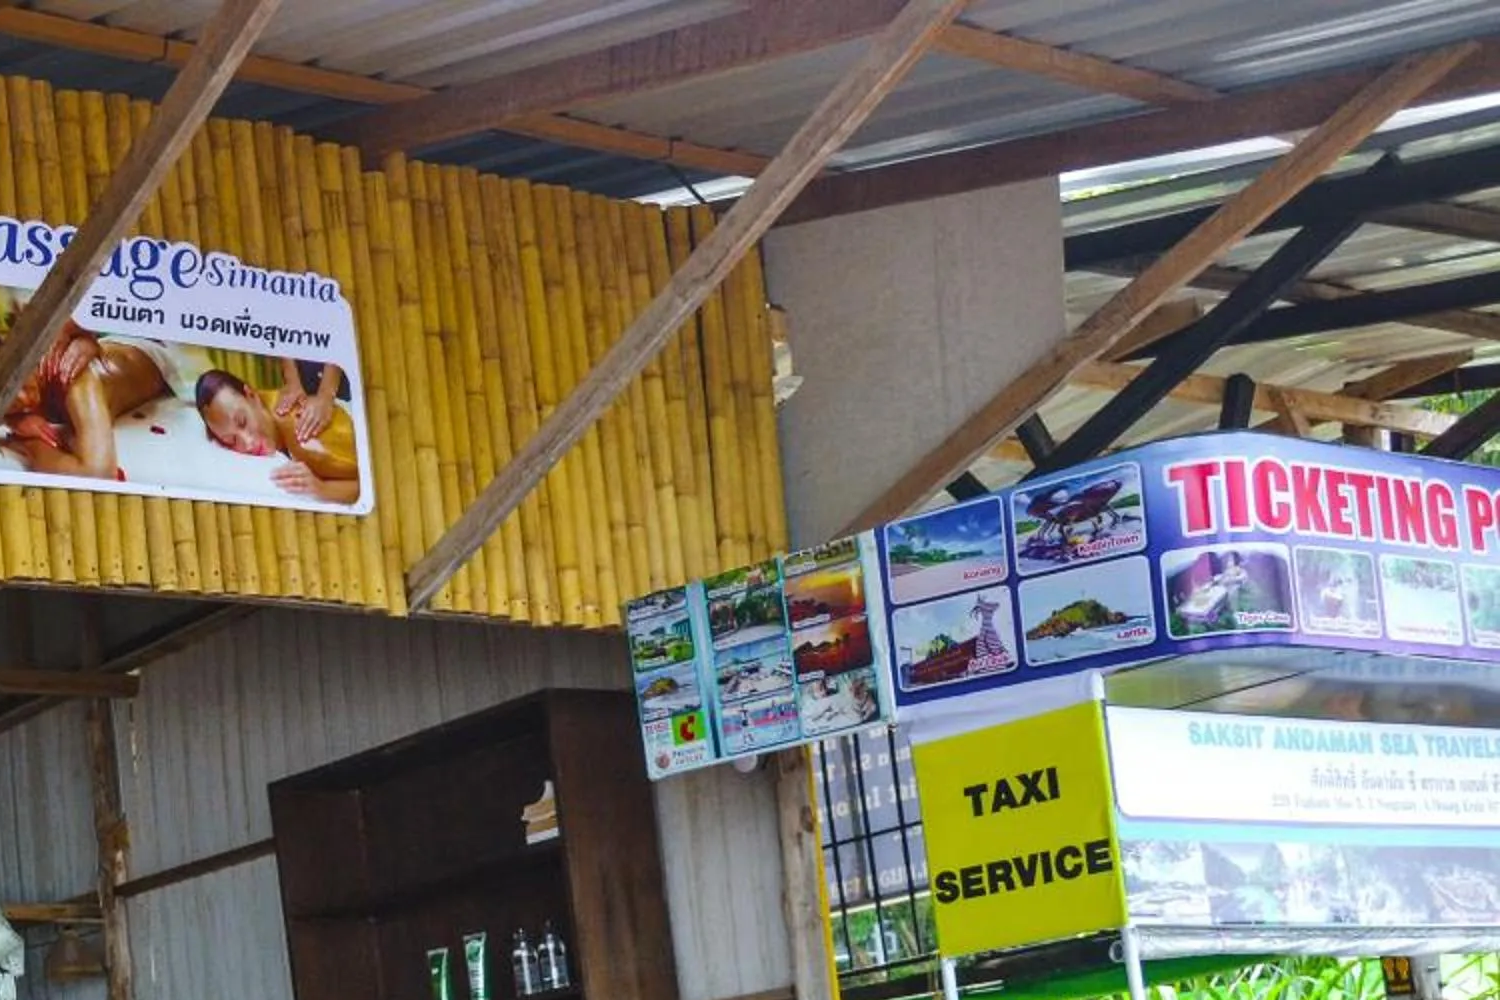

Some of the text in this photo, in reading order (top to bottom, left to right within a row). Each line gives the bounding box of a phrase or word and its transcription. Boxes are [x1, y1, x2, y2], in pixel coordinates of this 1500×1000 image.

[206, 256, 338, 304] Simanta
[1167, 457, 1500, 552] TICKETING P
[1187, 721, 1265, 750] SAKSIT
[1273, 725, 1375, 754] ANDAMAN
[1380, 731, 1419, 757] SEA
[963, 766, 1061, 817] TAXI
[934, 838, 1114, 905] SERVICE
